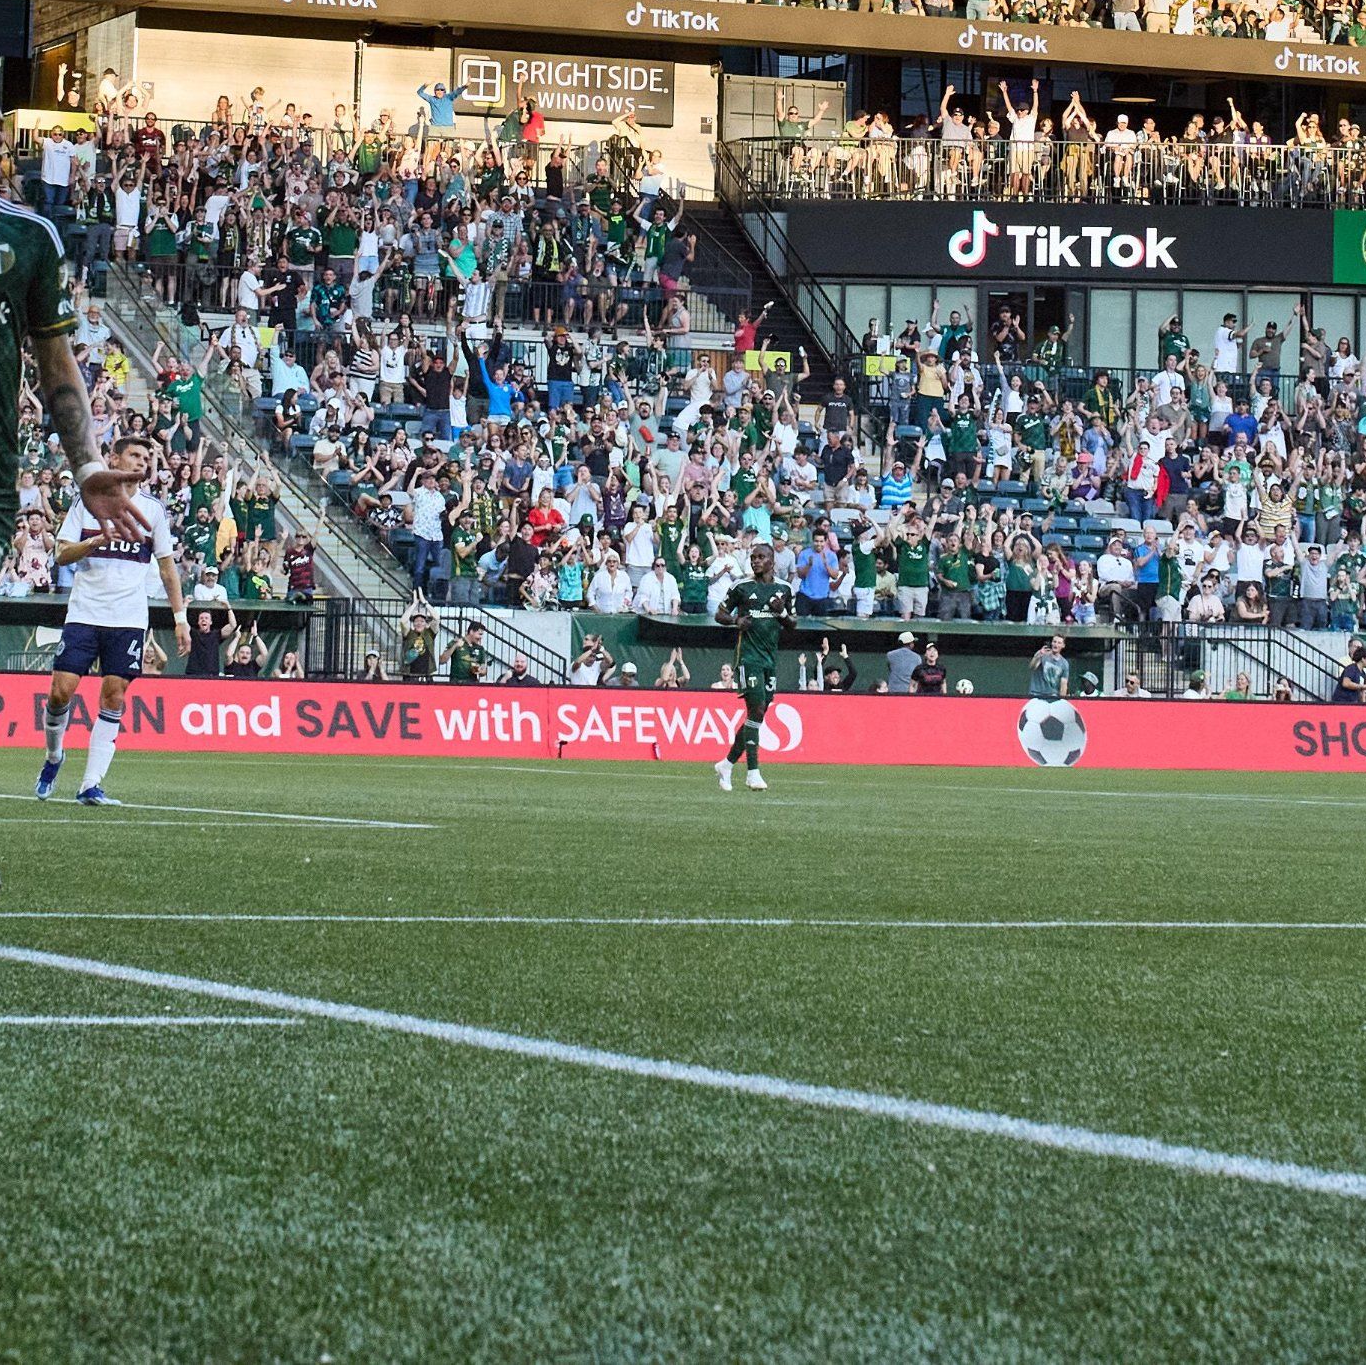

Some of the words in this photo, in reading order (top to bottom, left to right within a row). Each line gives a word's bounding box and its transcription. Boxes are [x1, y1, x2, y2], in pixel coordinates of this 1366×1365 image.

[650, 7, 720, 32] TikTok
[981, 31, 1048, 54] TikTok
[1296, 52, 1361, 76] TikTok
[537, 92, 636, 114] WINDOWS
[1006, 225, 1179, 269] TikTok
[126, 639, 142, 662] 4
[180, 696, 281, 737] and
[296, 700, 422, 740] SAVE
[434, 701, 542, 743] with
[557, 705, 744, 746] SAFEWAY
